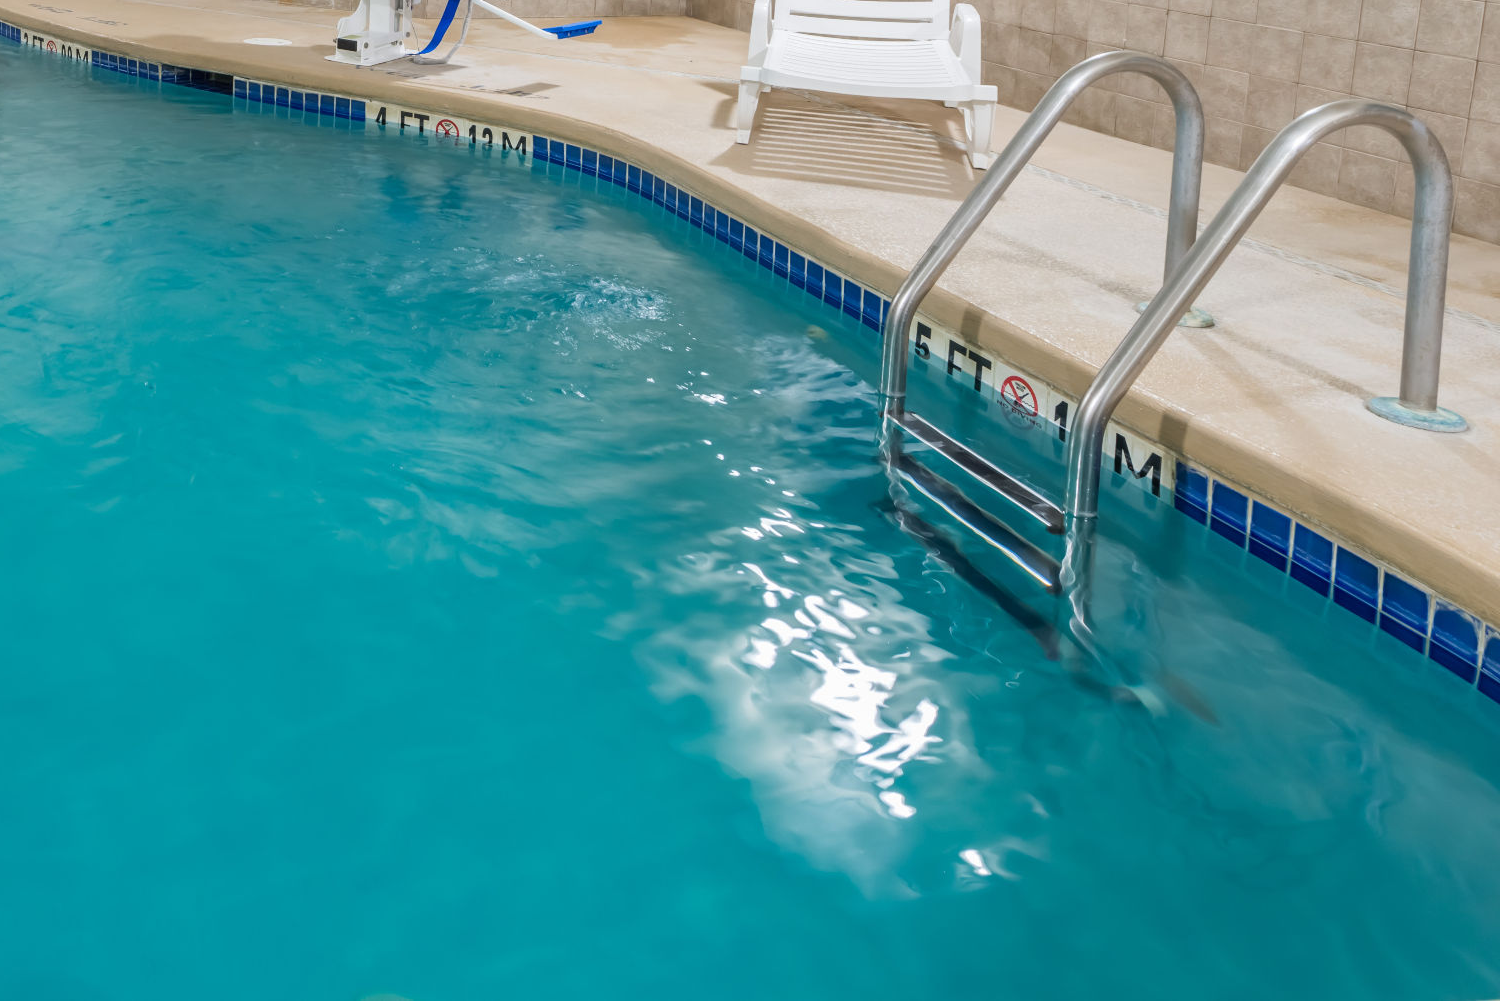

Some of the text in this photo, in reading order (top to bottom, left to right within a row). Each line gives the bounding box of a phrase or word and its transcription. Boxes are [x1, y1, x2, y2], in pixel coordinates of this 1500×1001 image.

[400, 110, 430, 133] FT
[502, 131, 526, 156] M
[915, 321, 932, 360] 5
[947, 339, 992, 393] FT
[1114, 432, 1162, 498] M
[996, 400, 1042, 429] NO DIVING
